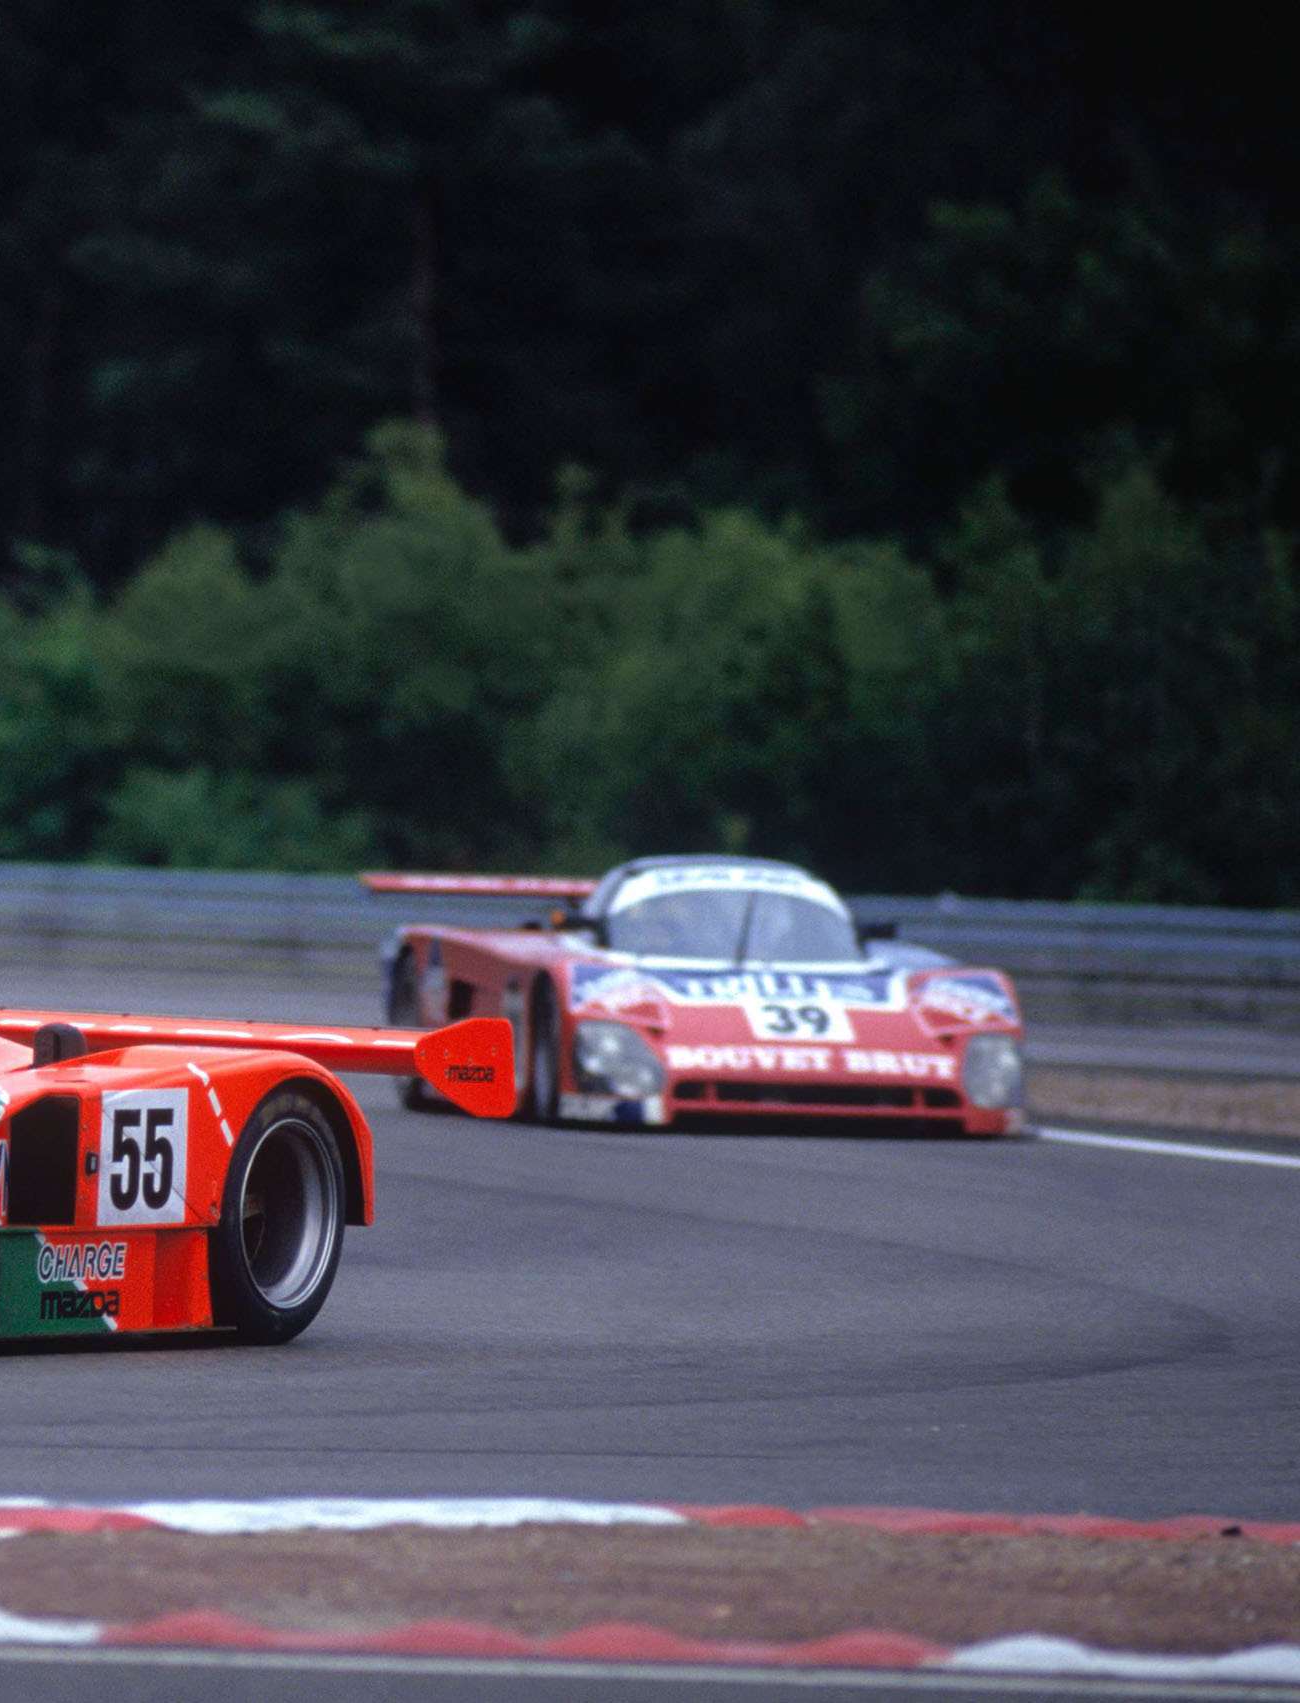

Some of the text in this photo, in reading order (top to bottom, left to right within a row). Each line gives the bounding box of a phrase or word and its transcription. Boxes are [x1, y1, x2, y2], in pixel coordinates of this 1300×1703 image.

[761, 1003, 830, 1035] 39
[447, 1064, 495, 1082] mazda
[665, 1045, 957, 1078] BOUVET BRUT
[109, 1107, 174, 1212] 55
[37, 1241, 127, 1283] CHARGE
[40, 1289, 120, 1320] mazda
